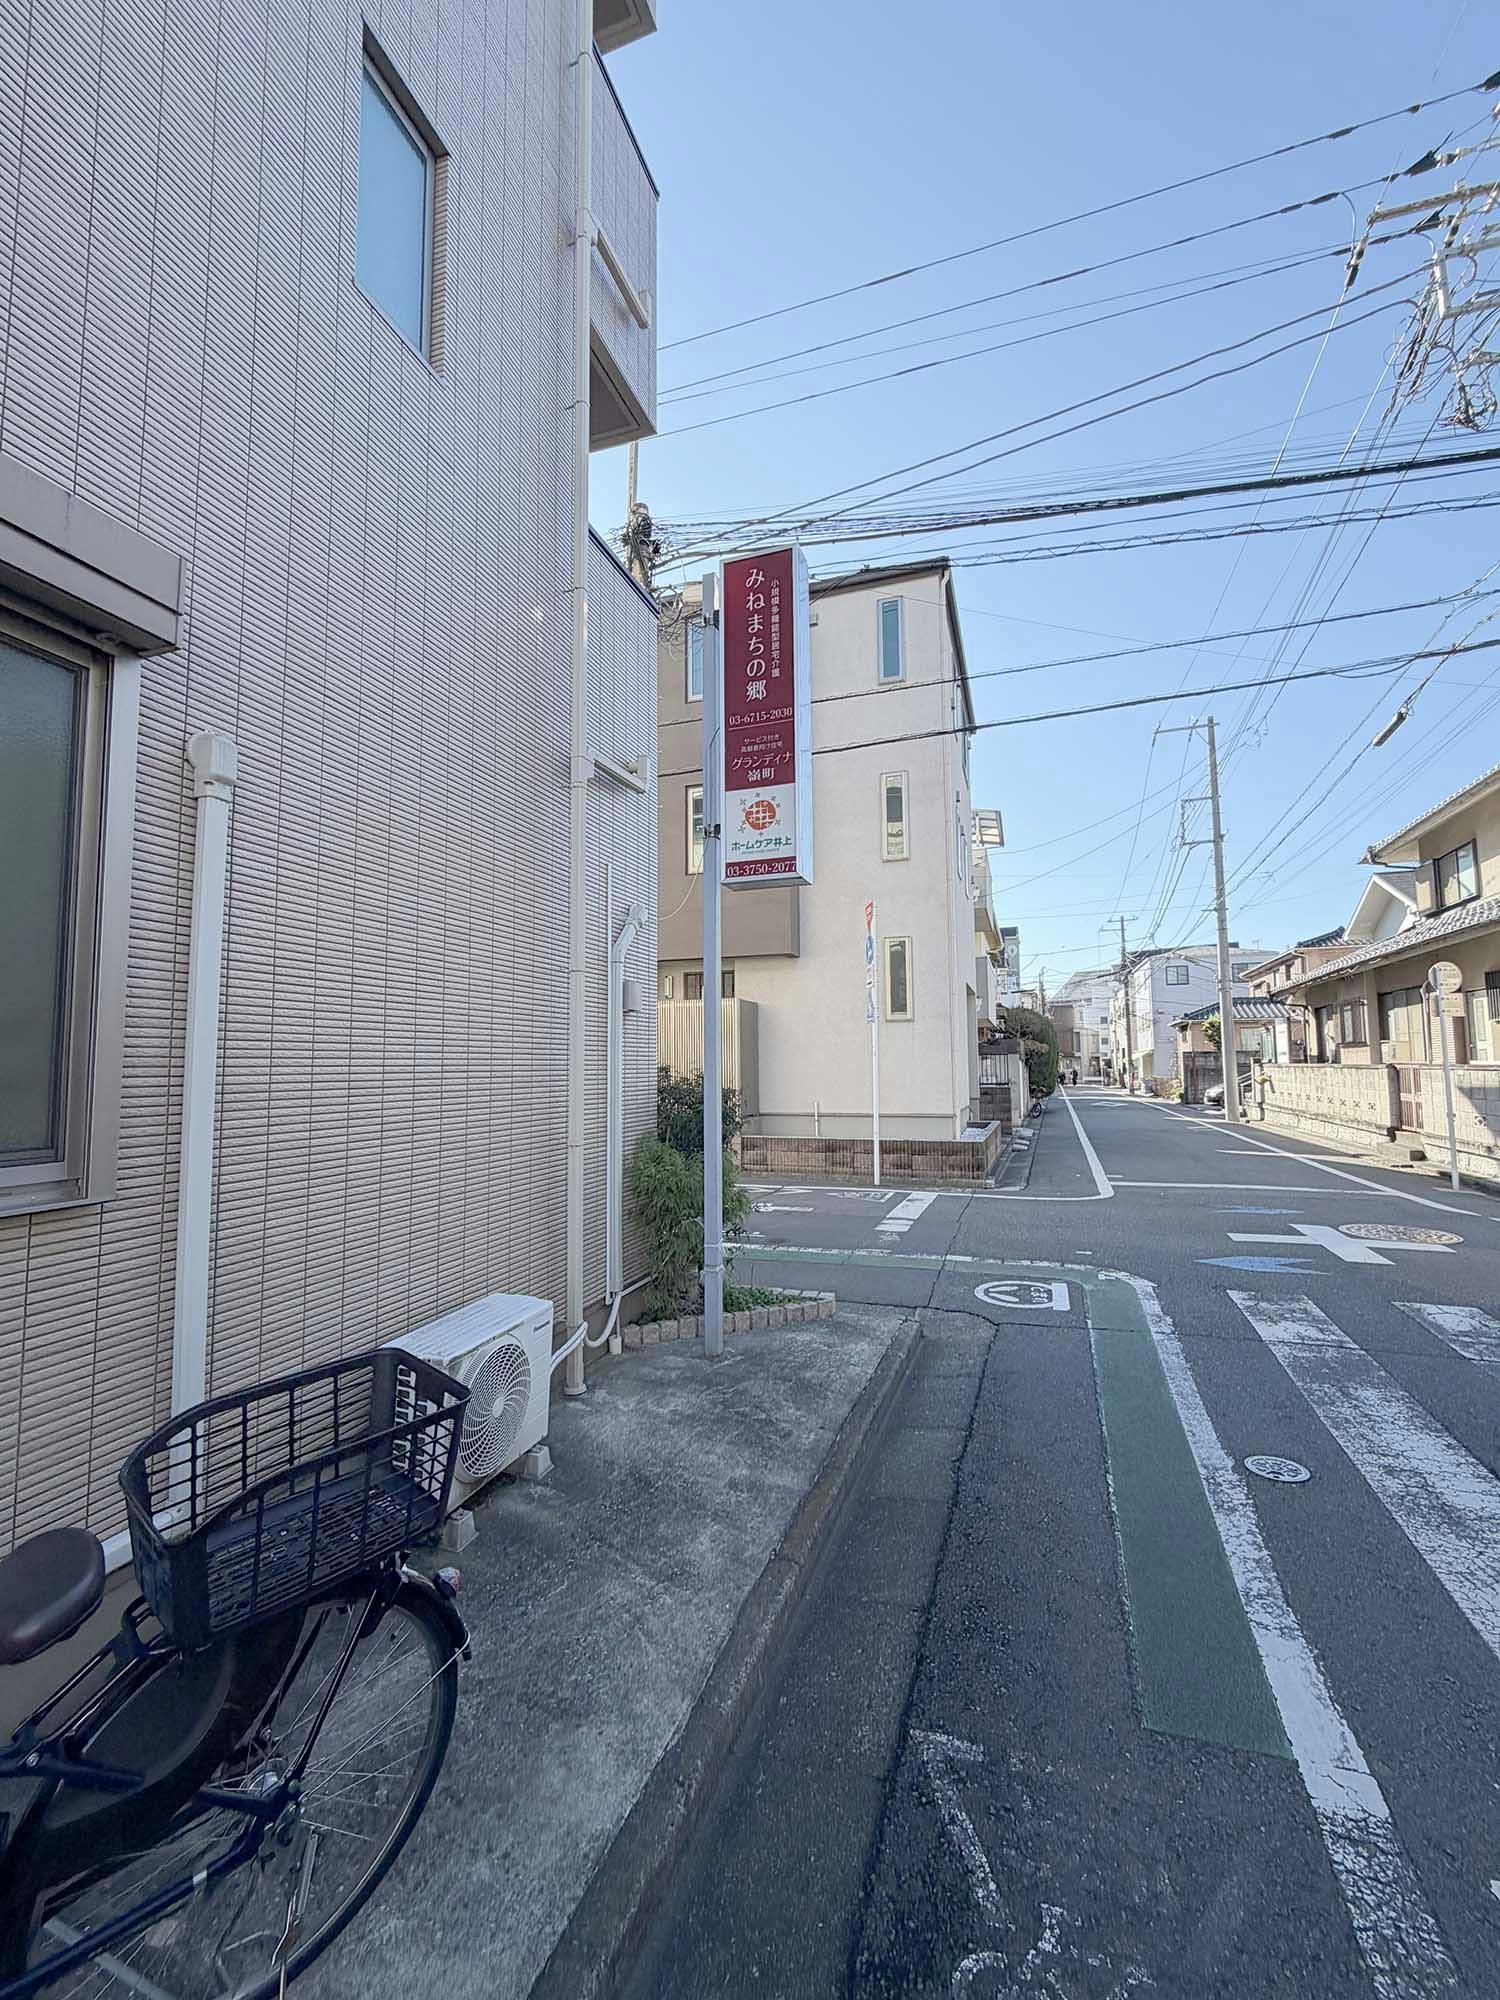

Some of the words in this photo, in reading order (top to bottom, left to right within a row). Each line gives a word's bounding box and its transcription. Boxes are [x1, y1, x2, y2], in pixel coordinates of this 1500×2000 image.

[746, 568, 768, 702] みねまちの郷
[729, 707, 793, 726] 03-6715-2030
[732, 751, 793, 770] グランディナ
[731, 836, 792, 851] ホームケア井上
[727, 860, 796, 877] 03-3750-2077
